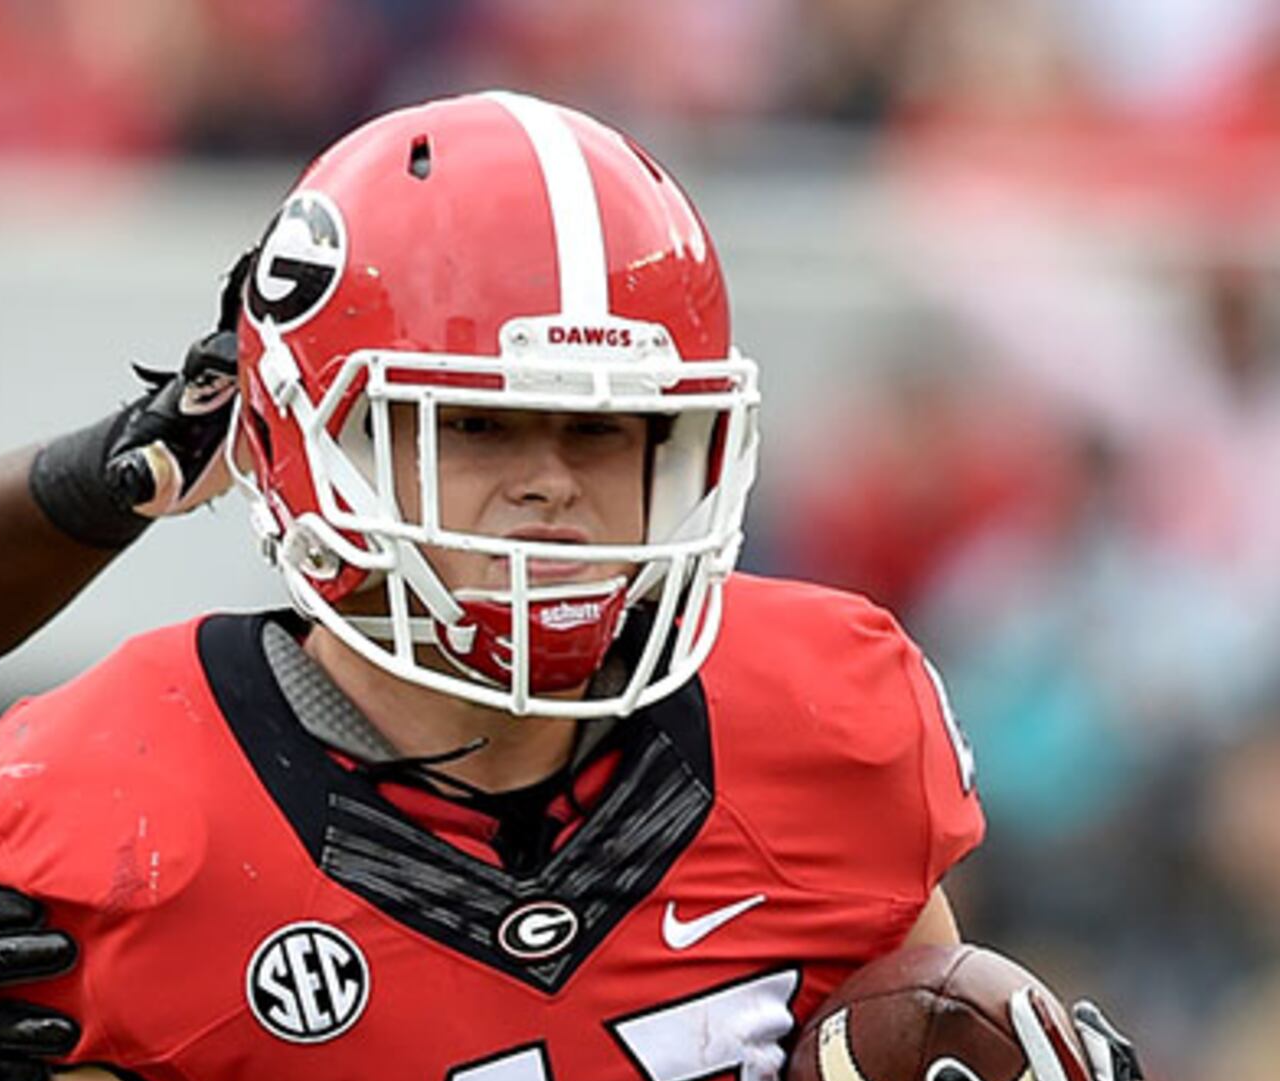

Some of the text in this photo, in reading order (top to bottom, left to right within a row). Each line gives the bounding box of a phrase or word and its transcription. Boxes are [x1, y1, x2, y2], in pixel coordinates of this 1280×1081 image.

[246, 197, 342, 326] G
[547, 326, 633, 348] DAWGS
[501, 904, 576, 956] G
[257, 933, 361, 1033] SEC
